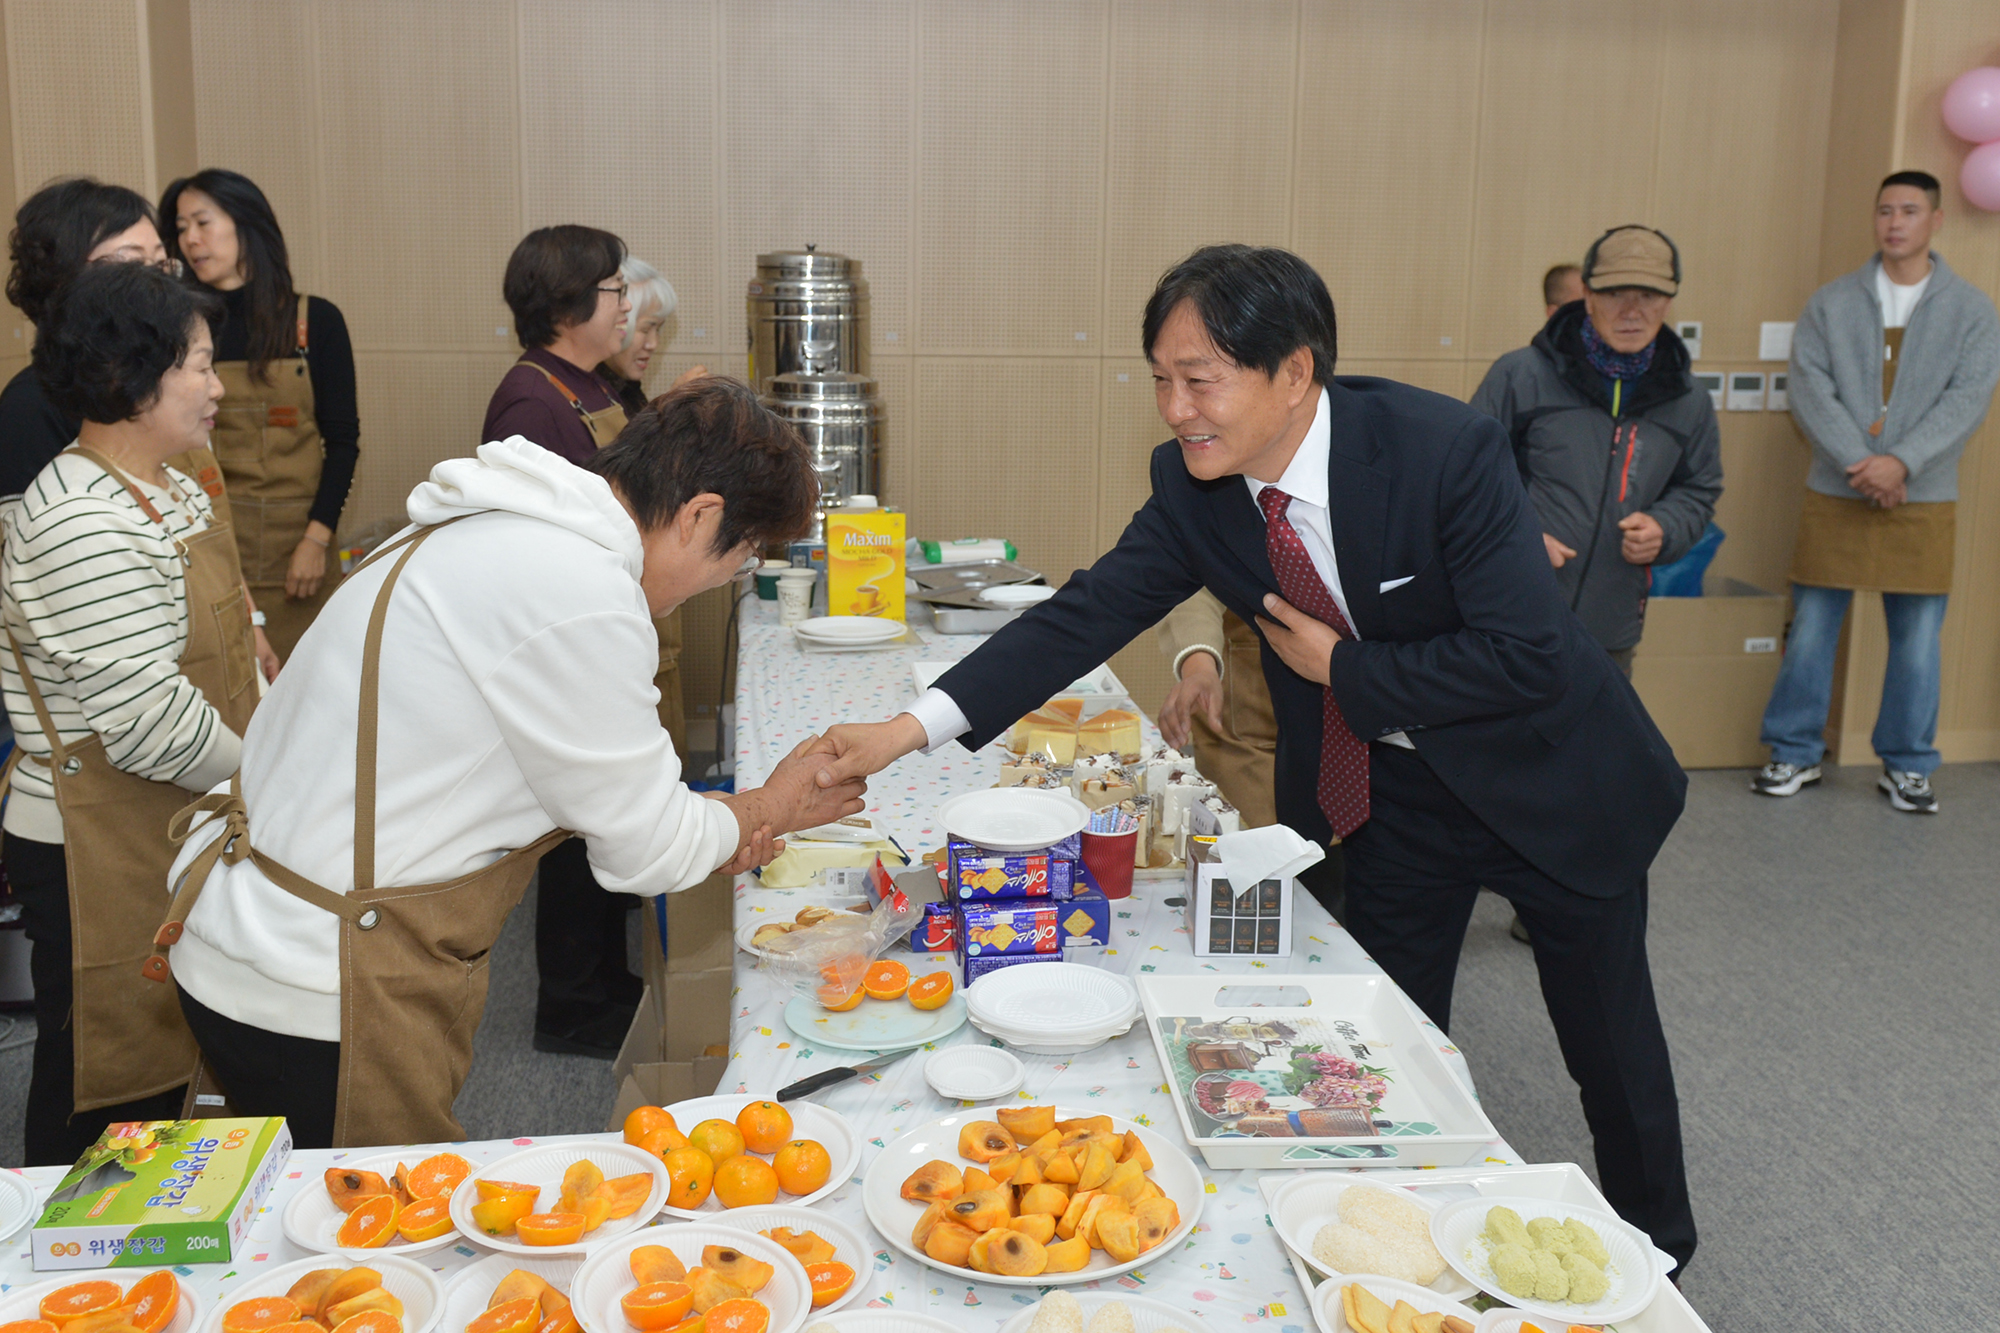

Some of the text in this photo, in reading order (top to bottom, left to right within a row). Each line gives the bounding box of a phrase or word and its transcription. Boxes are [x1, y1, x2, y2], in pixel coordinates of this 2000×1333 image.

[843, 530, 892, 546] Maxim
[1334, 1020, 1372, 1061] Coffee Time
[145, 1137, 220, 1208] 위생장갑
[88, 1237, 166, 1256] 위생장갑
[186, 1236, 219, 1251] 200매
